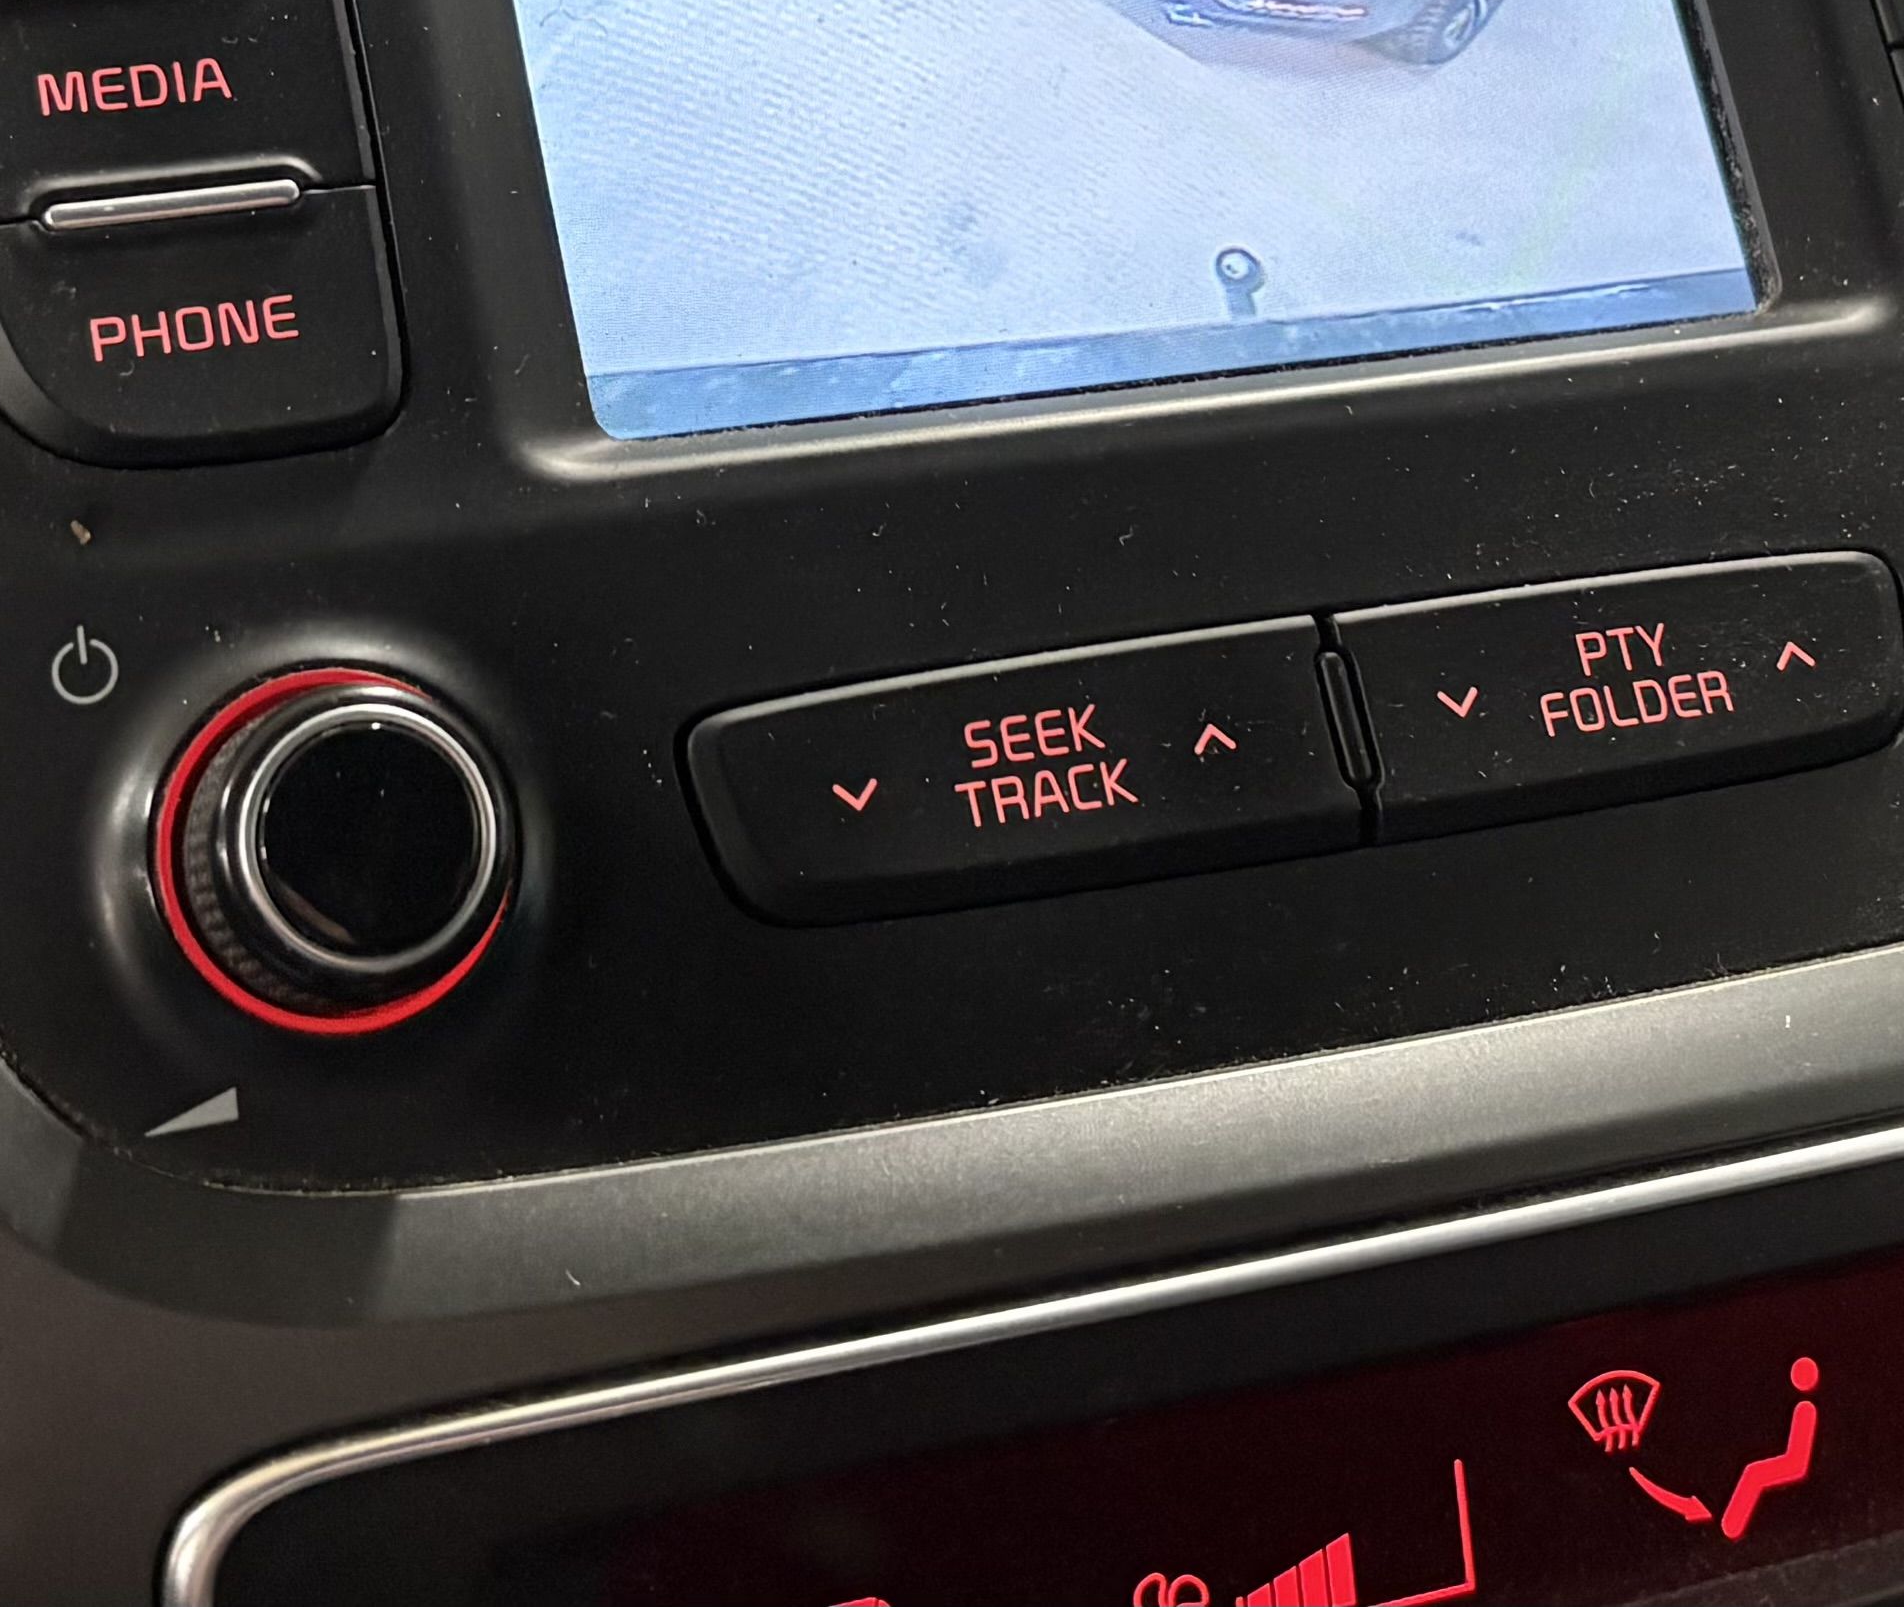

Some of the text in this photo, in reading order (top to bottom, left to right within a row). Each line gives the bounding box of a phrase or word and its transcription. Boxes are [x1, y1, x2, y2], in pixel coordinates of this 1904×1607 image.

[36, 57, 233, 116] MEDIA
[90, 294, 299, 363] PHONE
[1576, 623, 1667, 677] PTY
[1539, 670, 1734, 736] FOLDER
[963, 704, 1106, 771] SEEK
[953, 759, 1139, 828] TRACK
